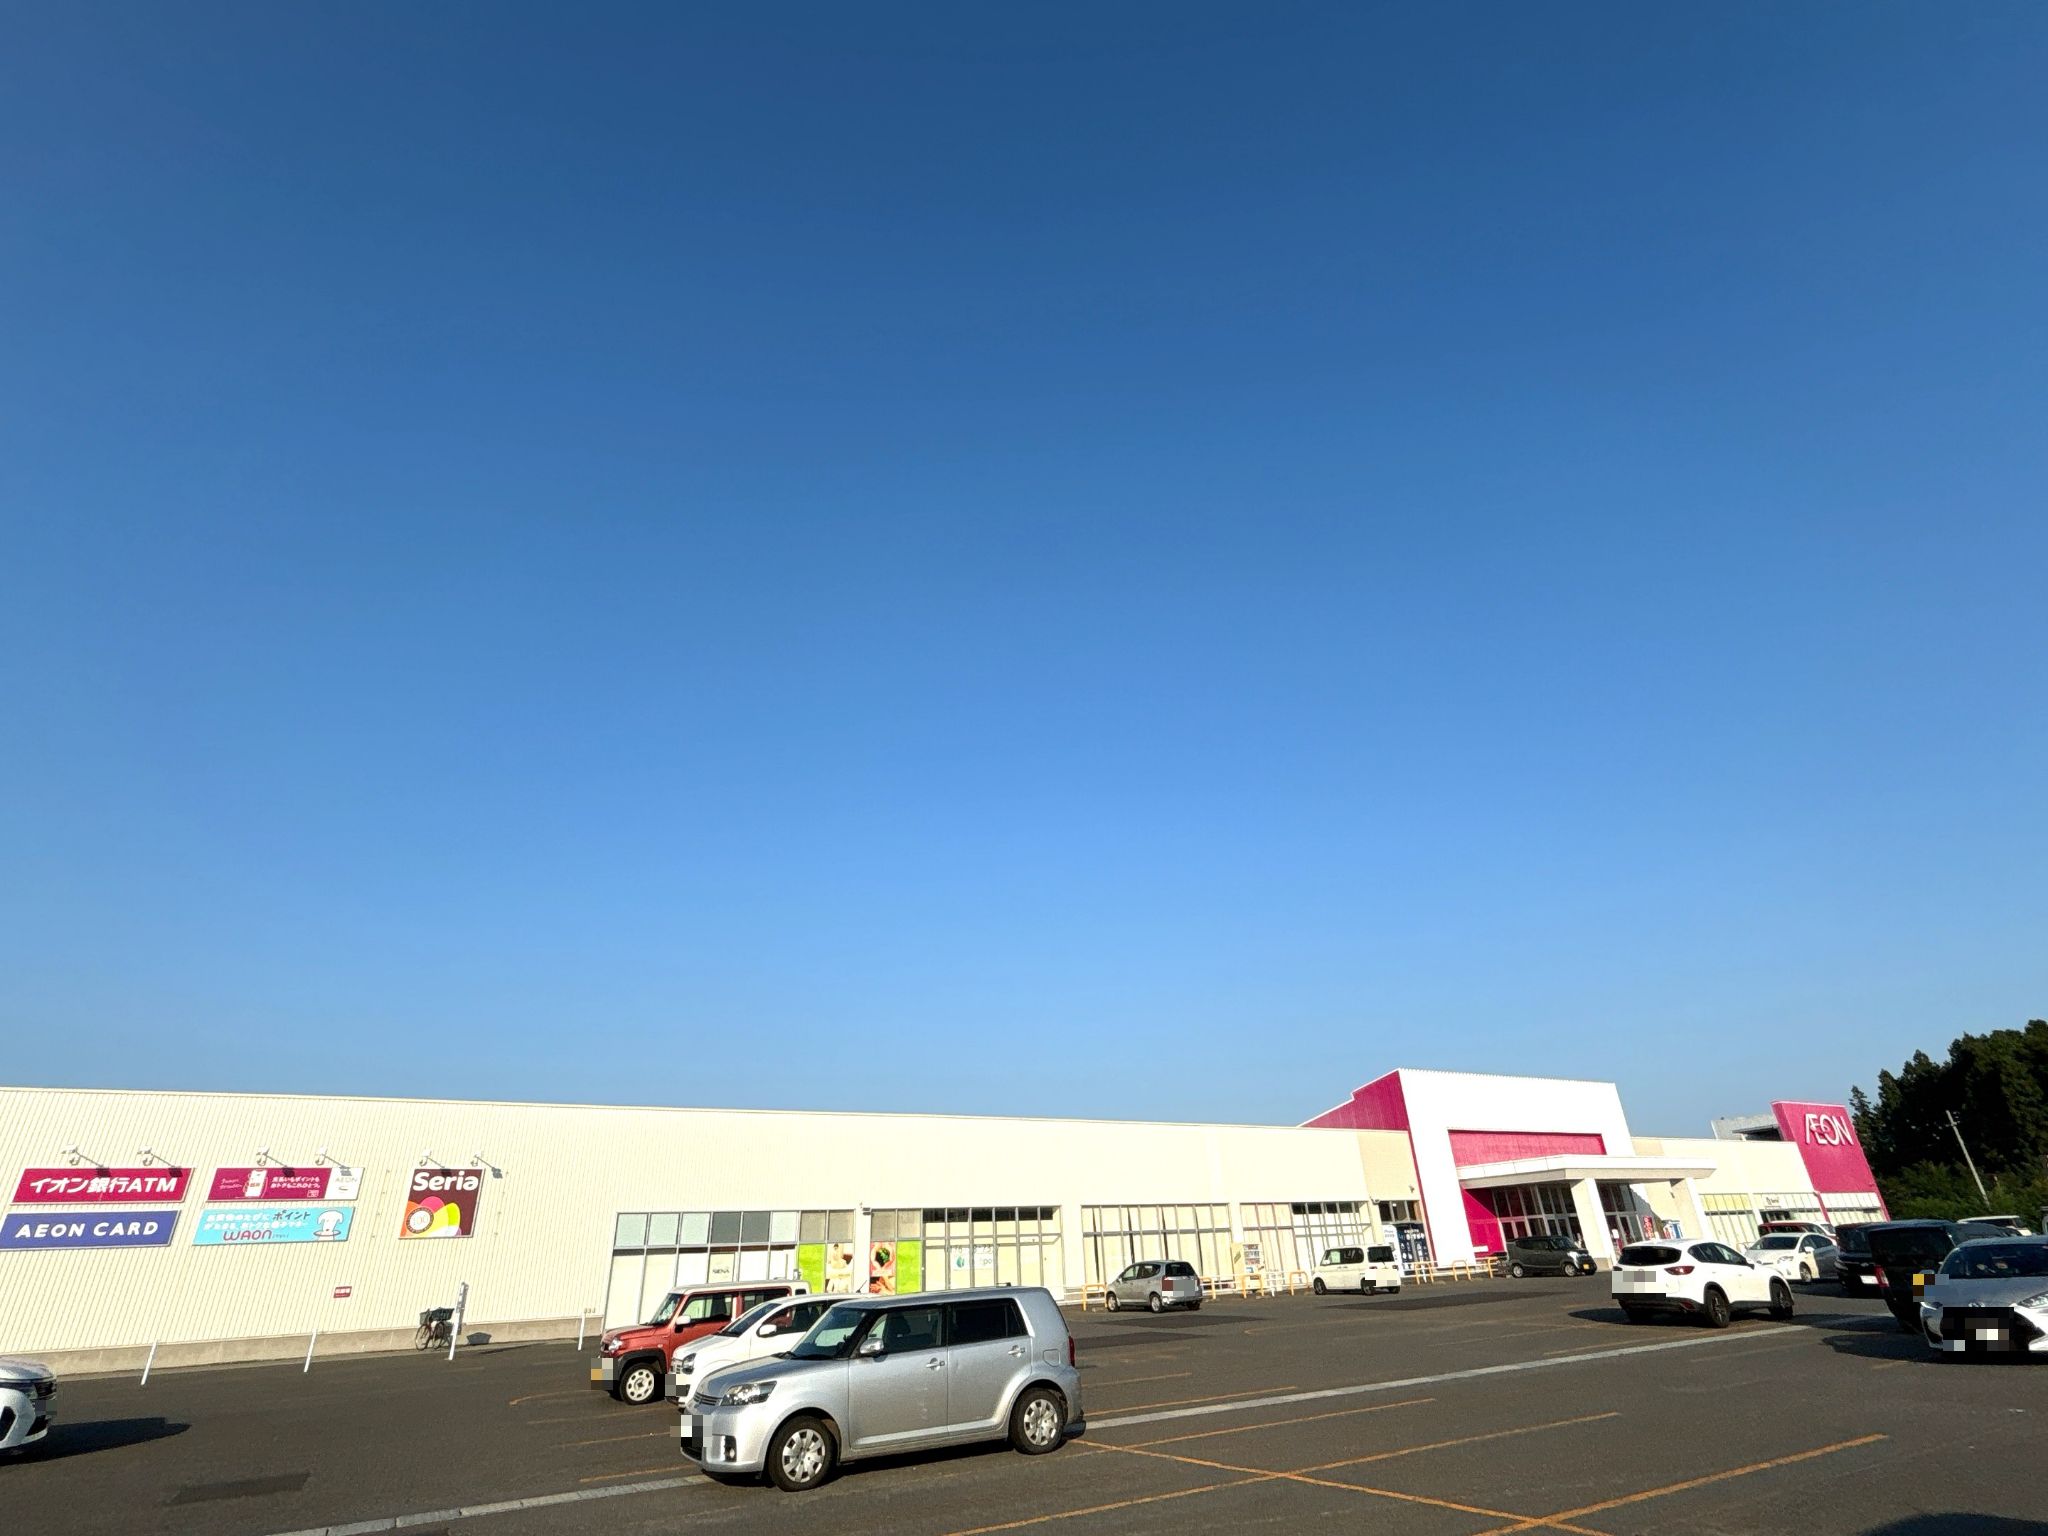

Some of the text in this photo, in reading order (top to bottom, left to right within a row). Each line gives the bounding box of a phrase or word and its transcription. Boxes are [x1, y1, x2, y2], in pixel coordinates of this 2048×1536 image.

[30, 1177, 177, 1193] イオン銀行ATM
[412, 1170, 479, 1191] Seria
[15, 1221, 159, 1238] AEON CARD
[223, 1229, 272, 1241] WAON
